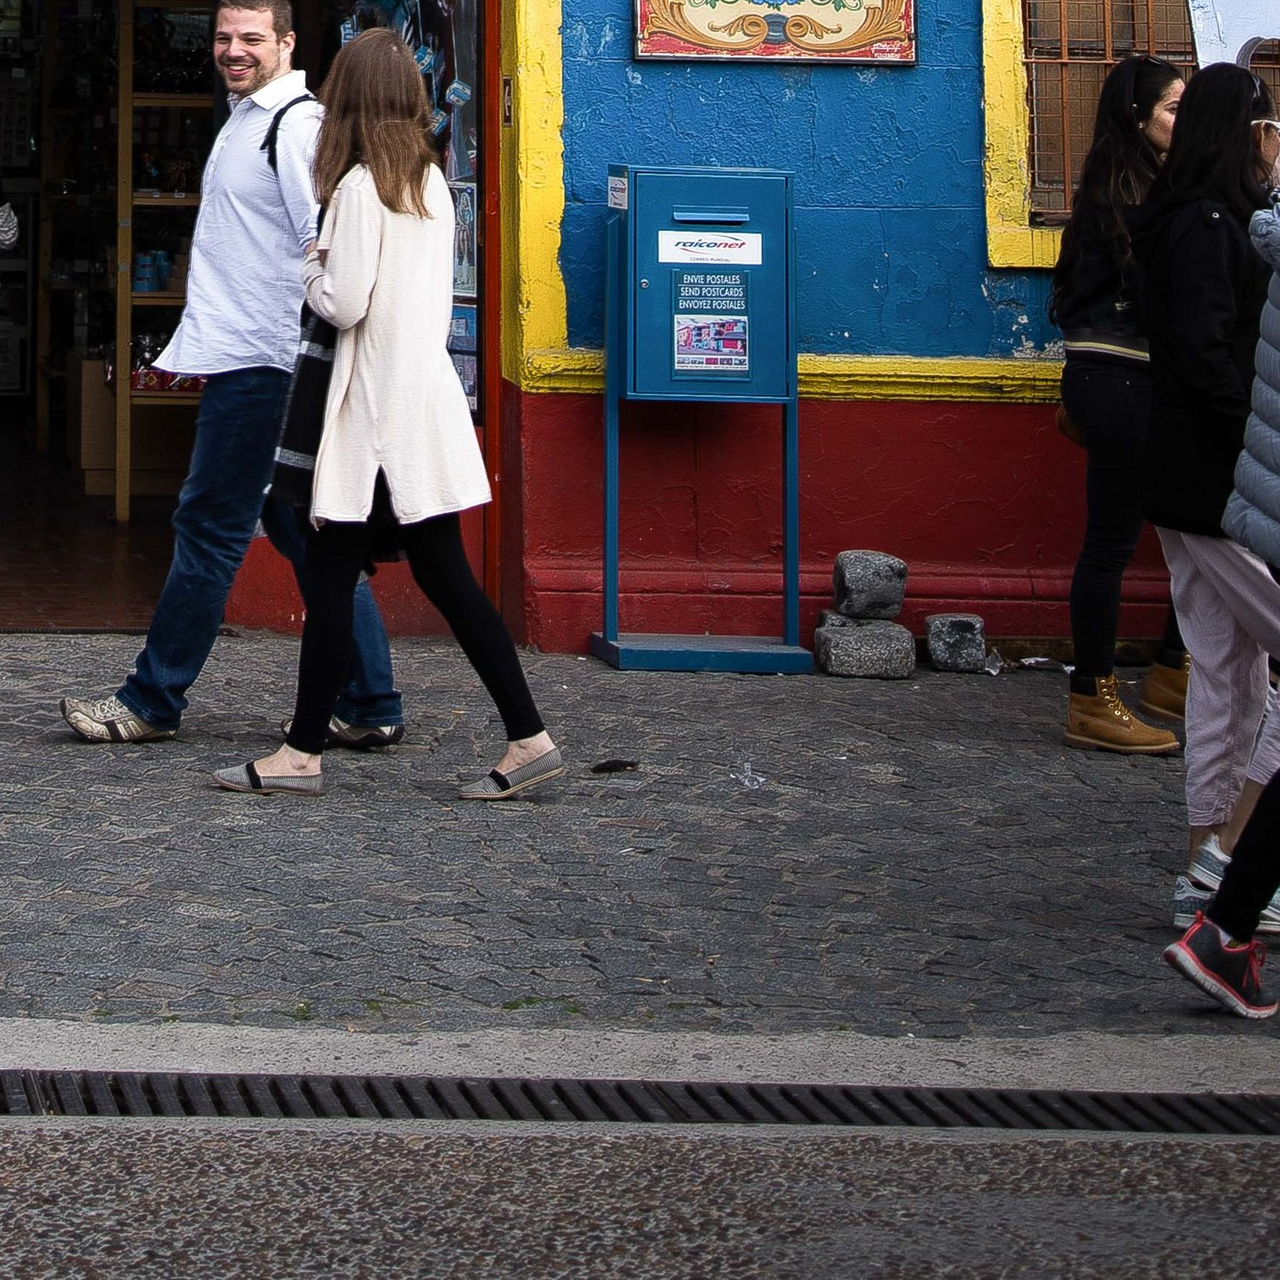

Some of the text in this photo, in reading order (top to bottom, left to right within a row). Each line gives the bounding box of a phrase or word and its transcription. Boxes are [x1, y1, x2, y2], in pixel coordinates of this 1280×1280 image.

[674, 239, 747, 249] raiconet
[683, 274, 741, 285] ENVIE POSTALES
[680, 287, 744, 297] SEND POSTCARDS
[678, 299, 746, 310] ENVOYEZ POSTALES
